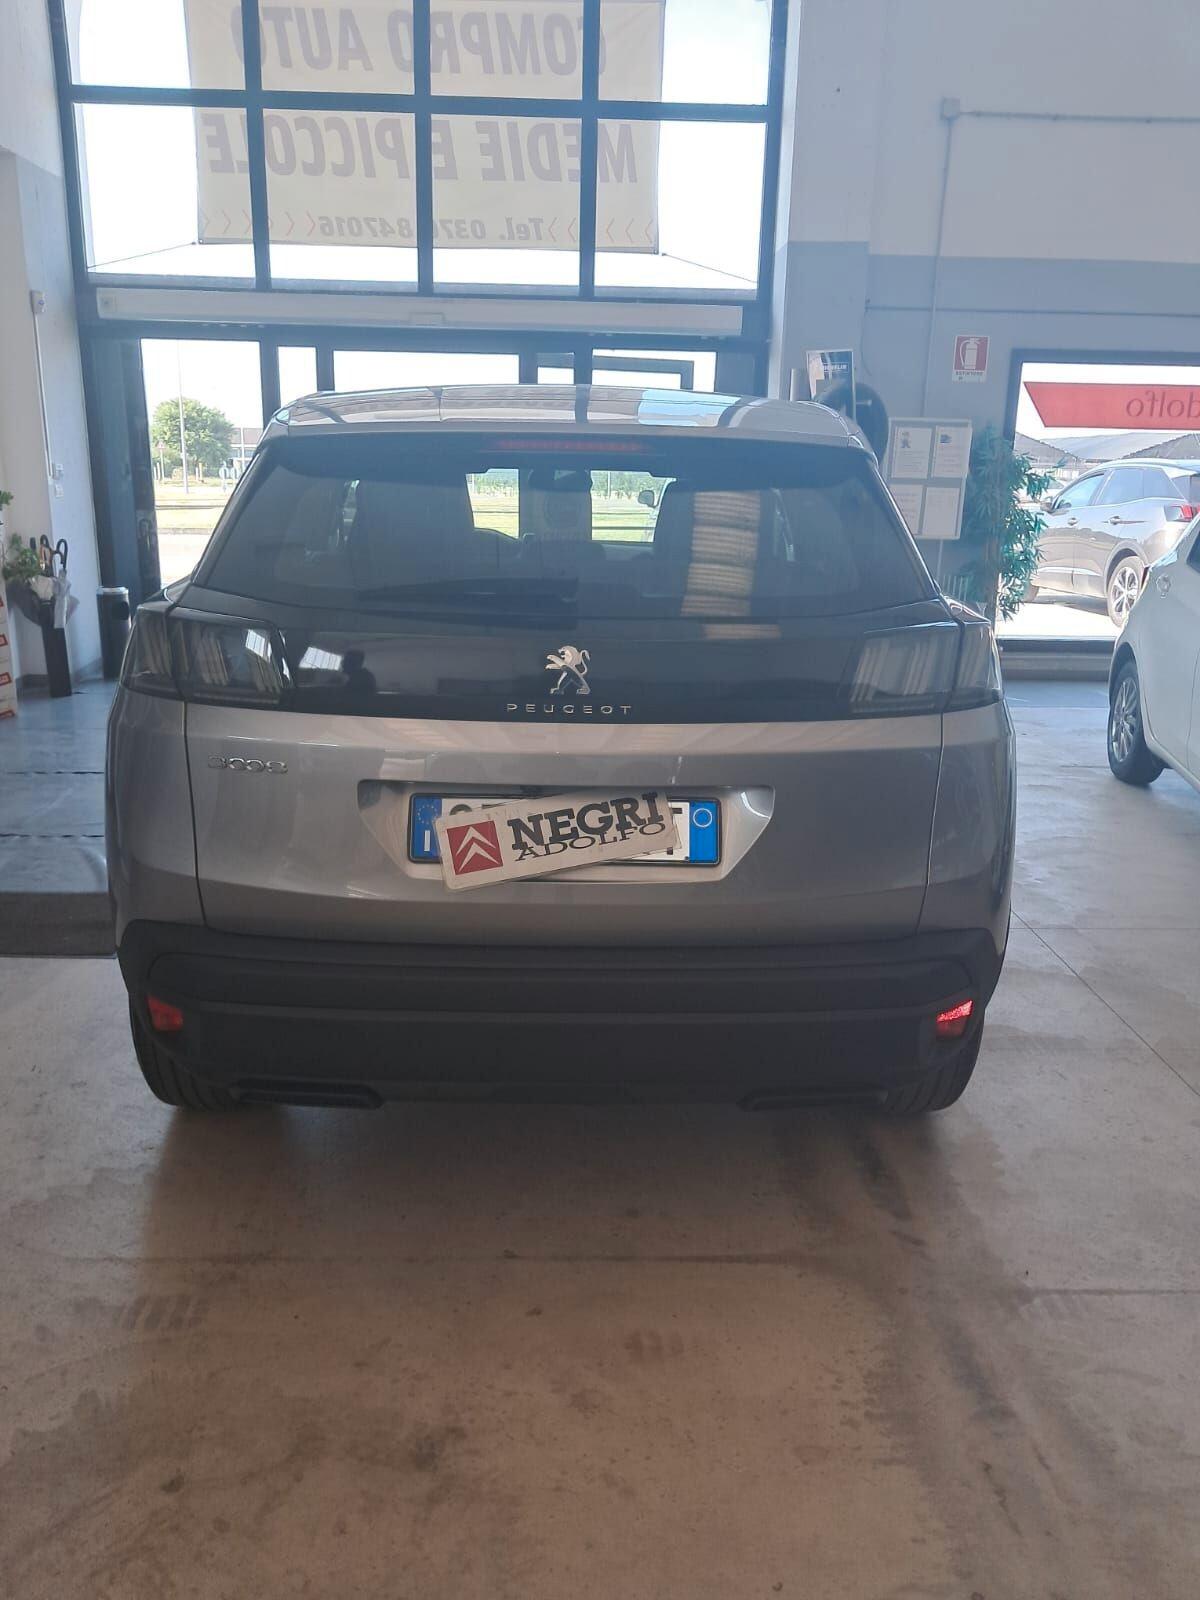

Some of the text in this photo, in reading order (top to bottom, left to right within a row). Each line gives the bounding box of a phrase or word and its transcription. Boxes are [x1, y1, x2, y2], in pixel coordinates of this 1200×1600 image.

[506, 703, 632, 714] PEUGEOT
[507, 792, 664, 850] NEGRI
[515, 822, 666, 861] ADOLFO
